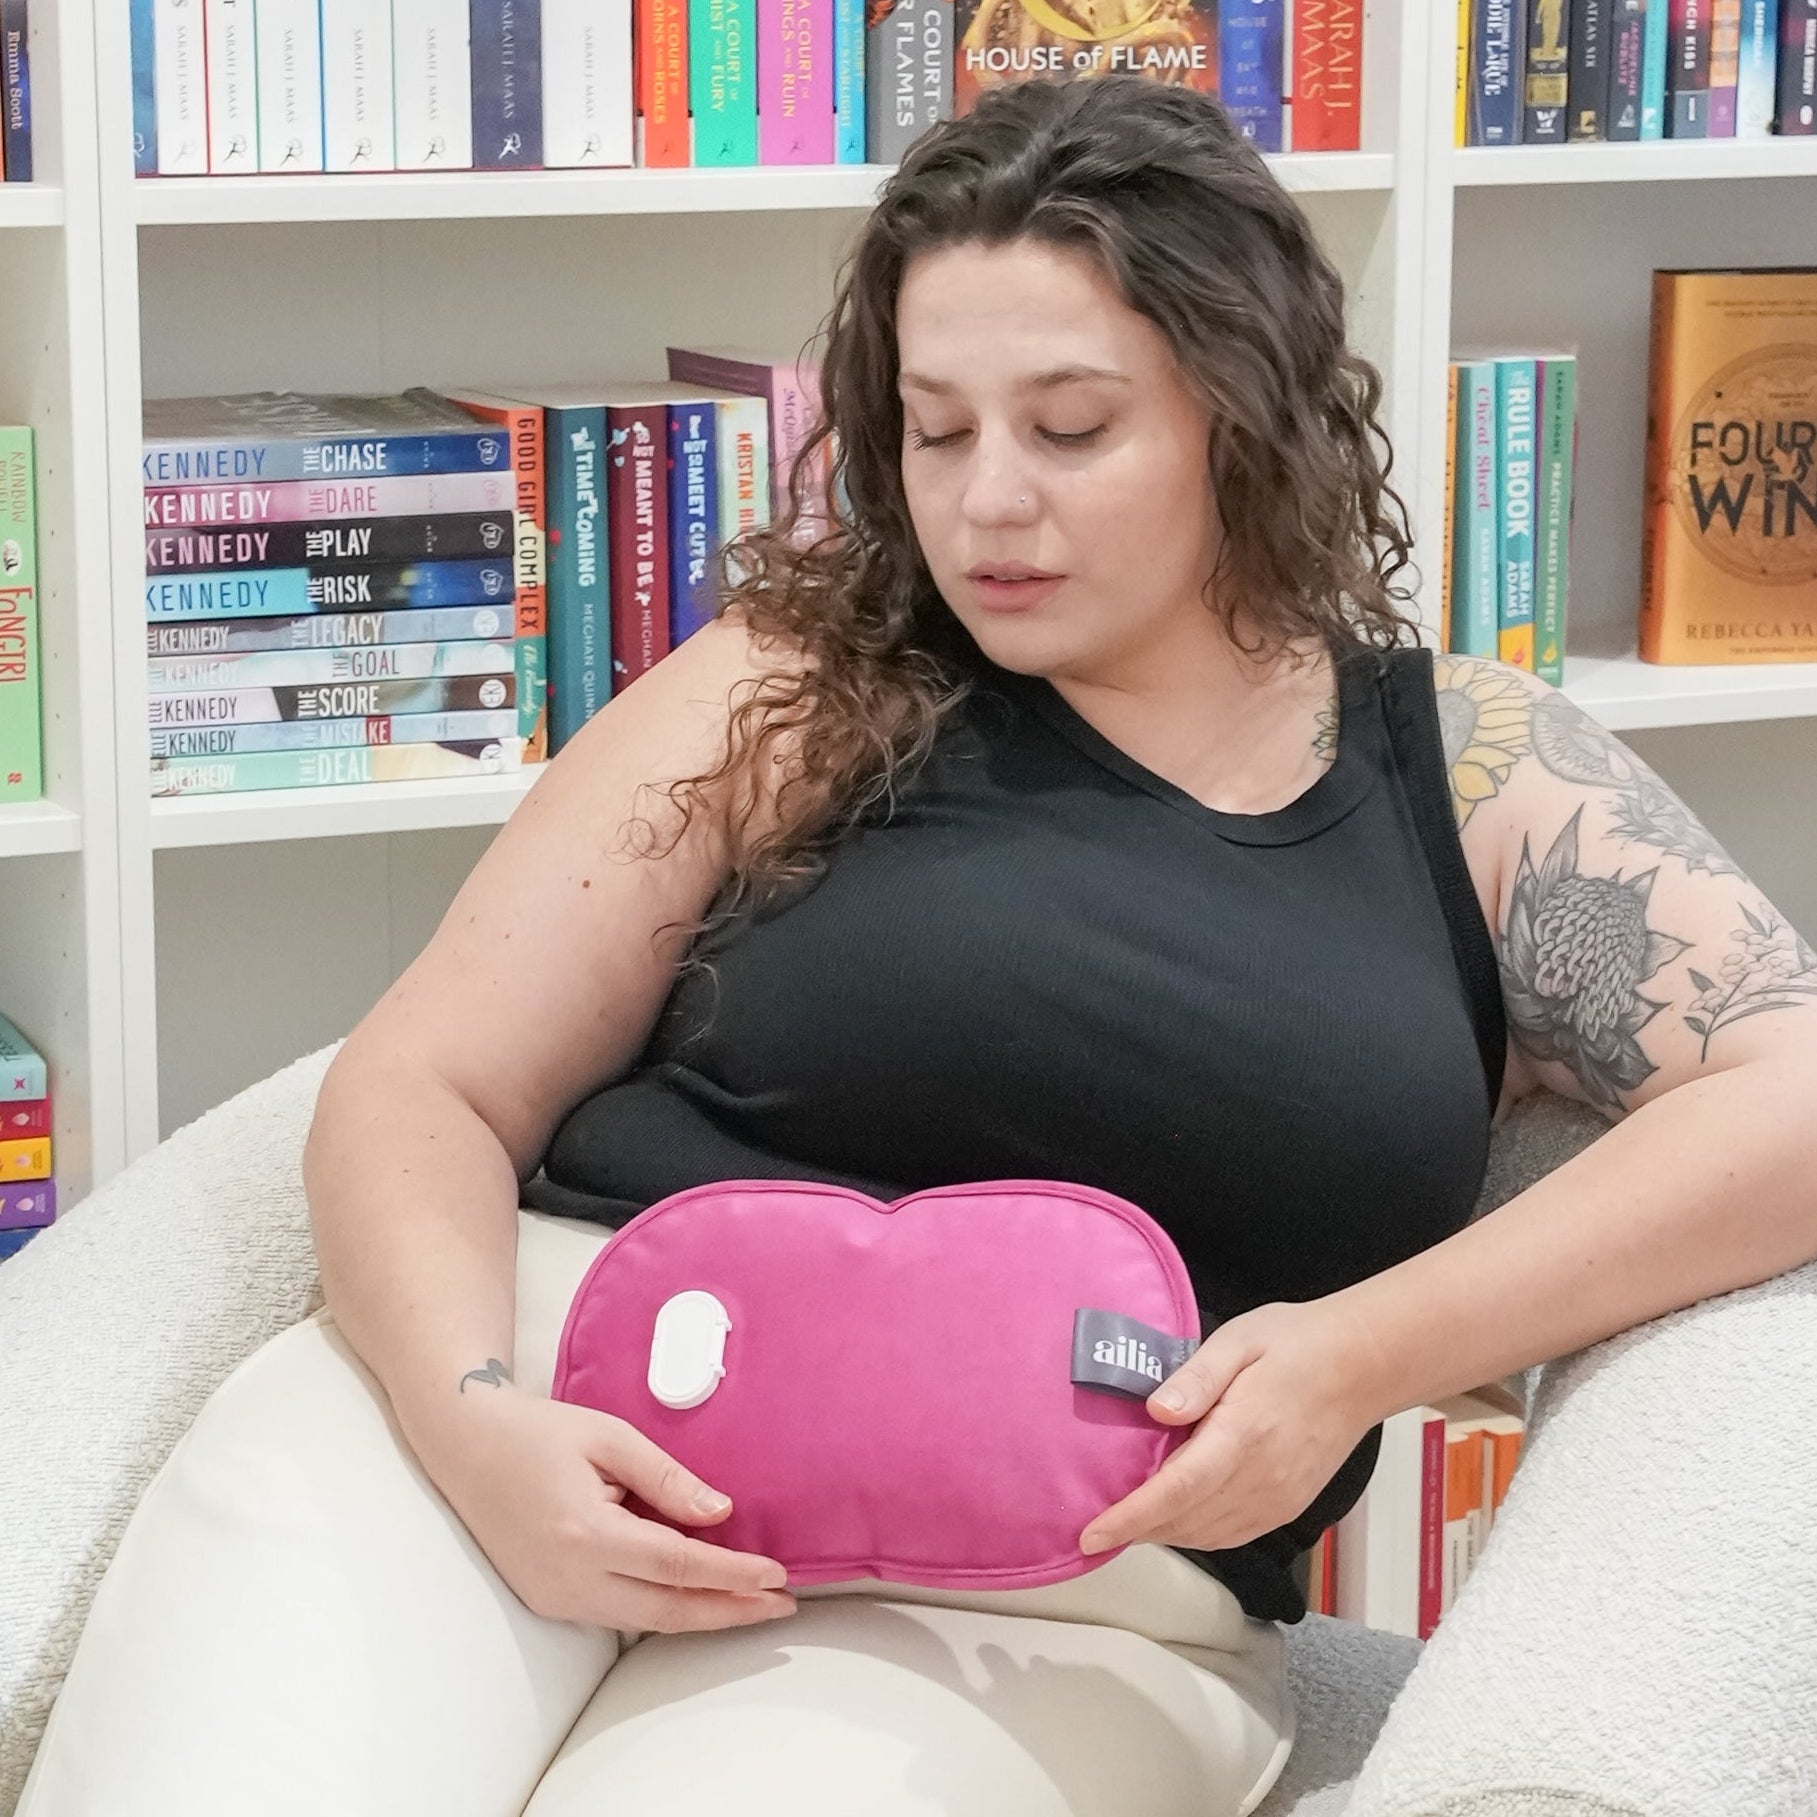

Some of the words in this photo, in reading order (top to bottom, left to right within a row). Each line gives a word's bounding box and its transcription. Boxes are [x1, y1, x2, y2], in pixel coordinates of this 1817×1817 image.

[502, 1, 515, 56] SARAH
[667, 6, 680, 17] A
[727, 1, 740, 13] A
[1585, 1, 1599, 41] ATLAS
[8, 30, 20, 83] Emma
[668, 23, 680, 77] COURT
[727, 19, 741, 82] COURT
[798, 18, 812, 81] COURT
[923, 10, 942, 102] COURT
[966, 46, 1064, 71] HOUSE
[1073, 45, 1103, 70] of
[1111, 45, 1207, 70] FLAME
[1301, 0, 1326, 100] MAAS
[1585, 46, 1597, 68] SIX
[1683, 36, 1697, 69] KISS
[504, 74, 515, 118] MAAS
[654, 71, 667, 125] ROSES
[711, 64, 725, 113] FURY
[782, 73, 796, 118] RUIN
[897, 22, 915, 127] FLAMES
[10, 88, 23, 130] Scott
[1323, 101, 1352, 117] J.
[1477, 386, 1489, 446] Cheat
[1507, 387, 1531, 454] RULE
[143, 447, 266, 480] KENNEDY
[303, 446, 321, 473] THE
[321, 442, 387, 473] CHASE
[517, 417, 536, 471] GOOD
[737, 432, 753, 500] KRISTAN
[11, 452, 26, 523] RAINBOW
[575, 451, 594, 501] TIME
[635, 460, 653, 526] MEANT
[688, 466, 705, 516] MEET
[1477, 455, 1491, 510] Sheet
[1506, 460, 1531, 538] BOOK
[1549, 461, 1562, 525] PRACTICE
[145, 490, 271, 524] KENNEDY
[309, 489, 324, 513] THE
[326, 486, 377, 513] DARE
[518, 481, 537, 526] GIRL
[146, 532, 270, 567] KENNEDY
[306, 530, 323, 557] THE
[322, 528, 373, 557] PLAY
[575, 502, 597, 587] COMING
[636, 532, 654, 556] TO
[1547, 529, 1559, 573] MAKES
[146, 580, 269, 613] KENNEDY
[306, 577, 323, 603] THE
[323, 575, 372, 604] RISK
[519, 536, 539, 629] COMPLEX
[637, 561, 654, 587] BE
[1506, 560, 1519, 618] ADAMS
[1518, 560, 1530, 616] SARAH
[1545, 576, 1557, 632] PERFECT
[159, 625, 230, 652] KENNEDY
[292, 619, 308, 647] THE
[312, 615, 383, 646] LEGACY
[583, 603, 596, 666] MEGHAN
[641, 609, 653, 668] MEGHAN
[1686, 623, 1782, 640] REBECCA
[332, 653, 349, 678] THE
[352, 650, 401, 677] GOAL
[165, 697, 237, 722] KENNEDY
[298, 690, 319, 717] THE
[319, 685, 380, 717] SCORE
[583, 671, 596, 719] QUINN
[169, 730, 237, 756] KENNEDY
[320, 720, 389, 747] MISTAKE
[167, 762, 237, 791] KENNEDY
[299, 756, 319, 782] THE
[318, 750, 373, 783] DEAL
[1093, 1336, 1163, 1382] ailia
